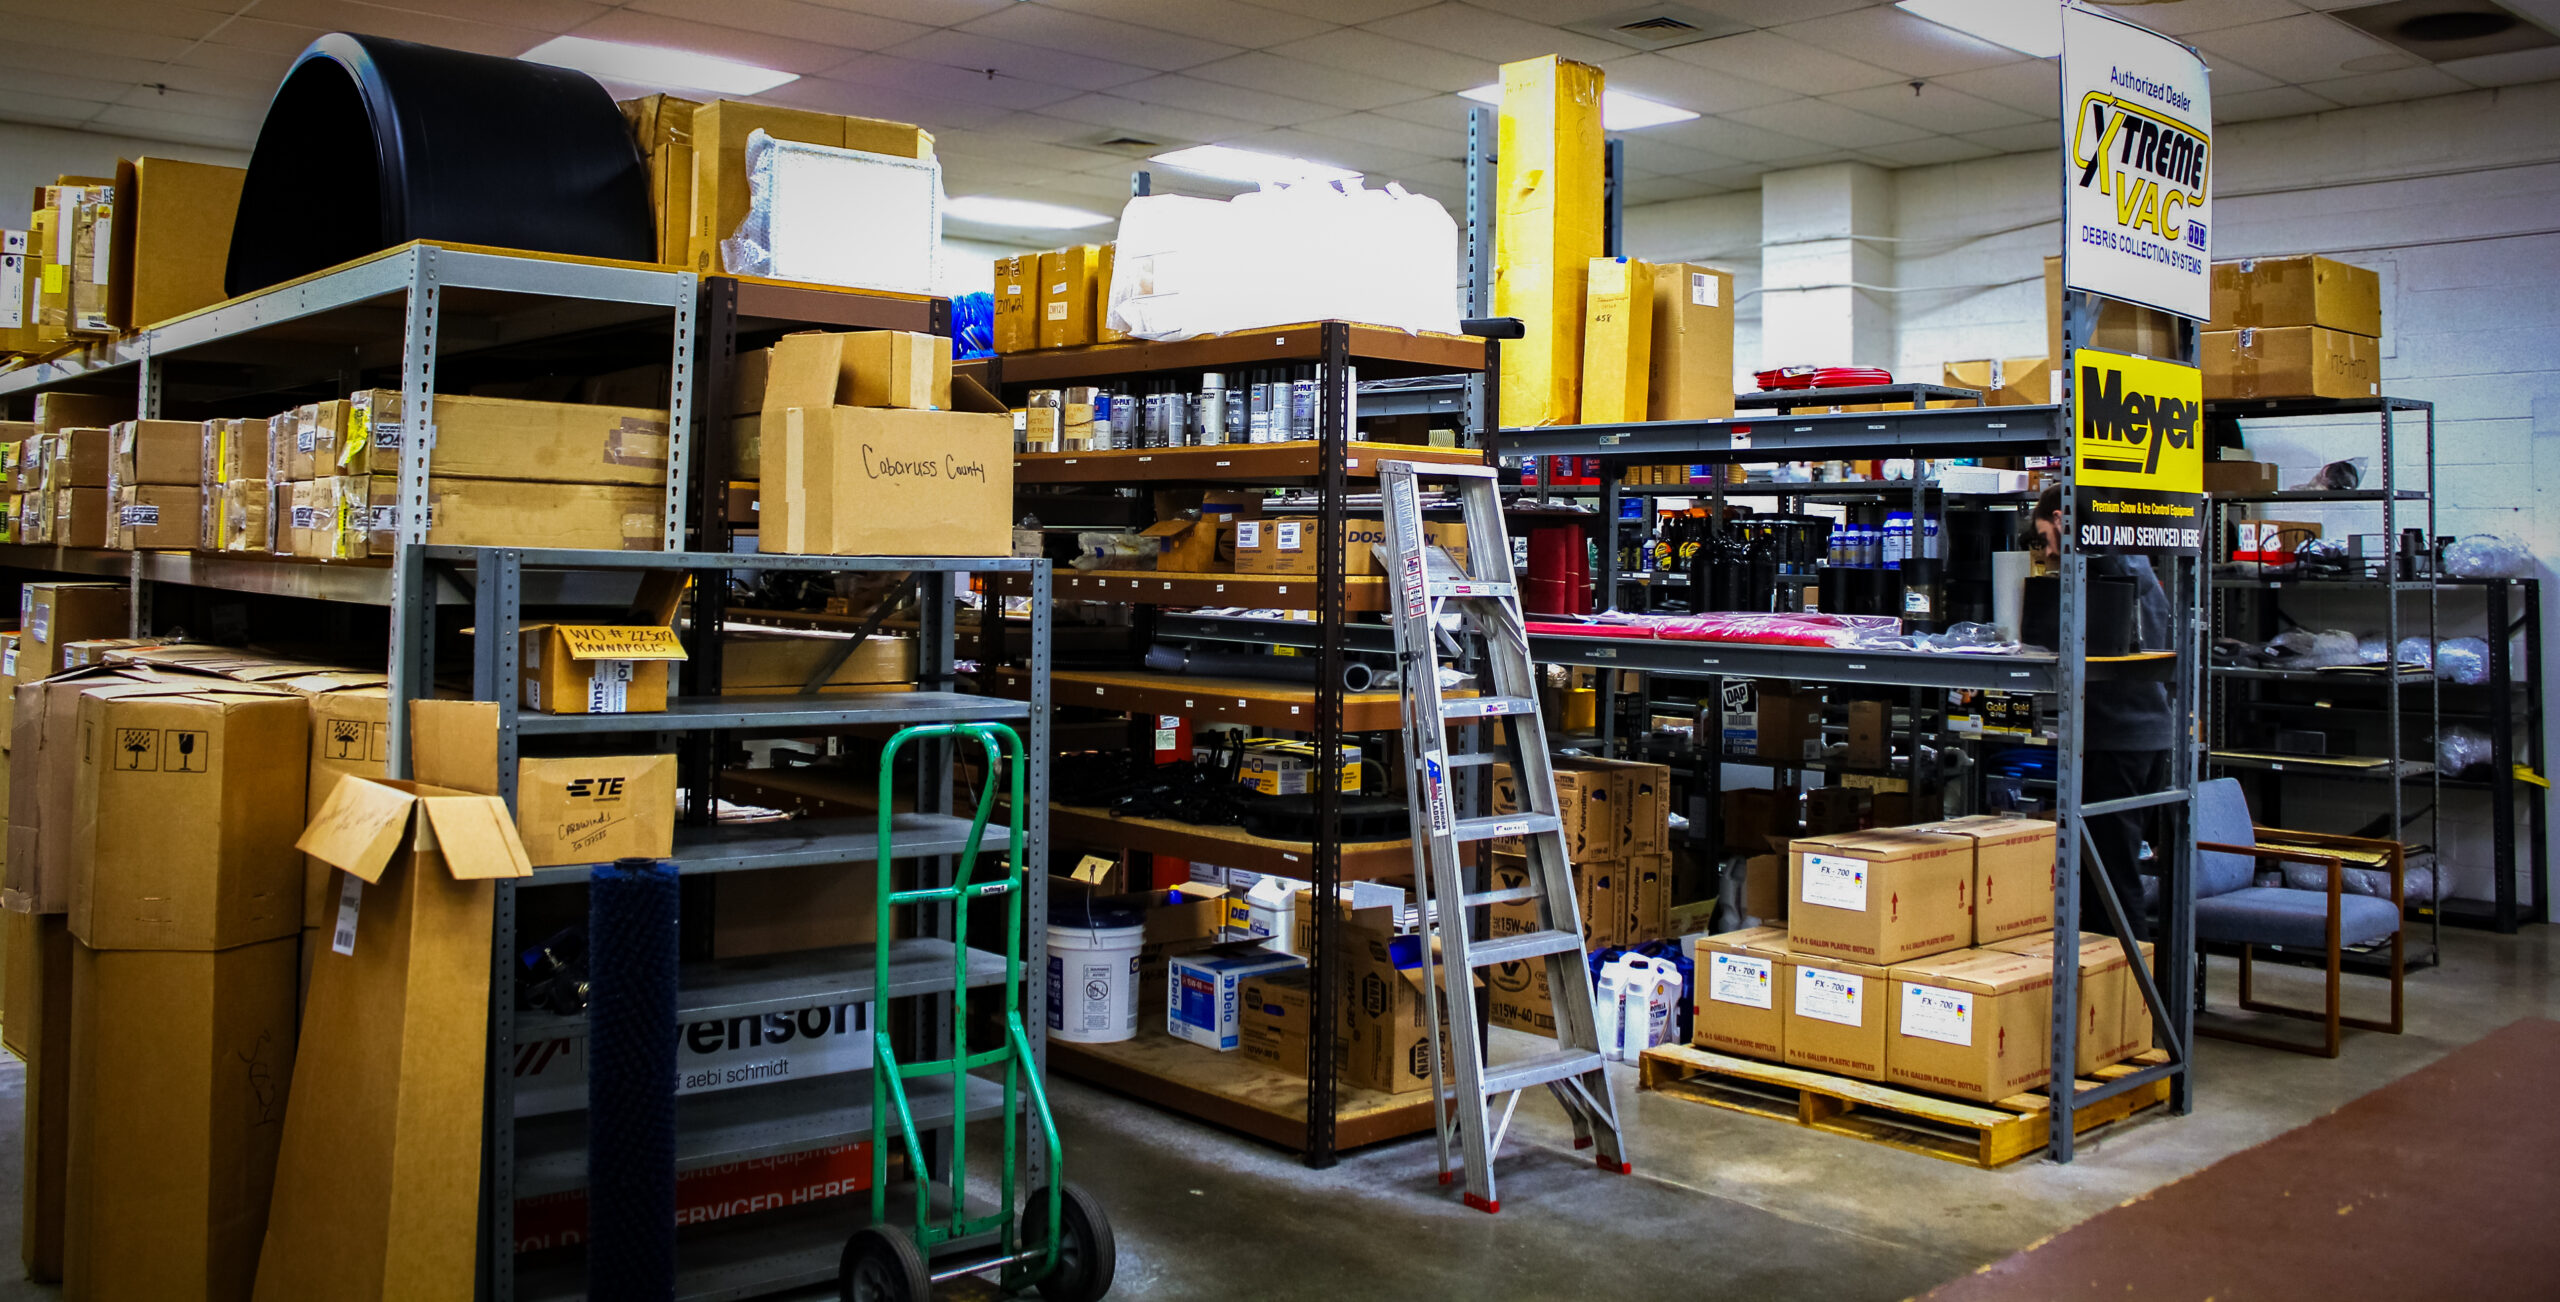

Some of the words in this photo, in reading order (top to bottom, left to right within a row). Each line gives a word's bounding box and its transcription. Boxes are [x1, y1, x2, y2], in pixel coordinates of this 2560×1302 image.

[2111, 66, 2164, 101] Authorized
[2166, 85, 2191, 112] Dealer
[2079, 104, 2204, 195] XTREME
[2116, 170, 2184, 240] VAC
[2082, 225, 2117, 250] DEBRIS
[2119, 236, 2170, 265] COLLECTION
[2171, 250, 2202, 275] SYSTEMS
[2082, 366, 2199, 475] Meyer
[862, 443, 938, 479] Cabaruss
[945, 453, 986, 484] County
[2092, 499, 2120, 513] Premium
[2120, 501, 2136, 514] Snow
[2136, 502, 2142, 514] &
[2142, 502, 2151, 514] Ice
[2151, 503, 2170, 516] Control
[2170, 504, 2195, 519] Equipment
[2081, 524, 2112, 546] SOLD
[2113, 526, 2135, 546] AND
[2136, 527, 2180, 547] SERVICED
[2181, 528, 2200, 548] HERE
[569, 628, 605, 641] WO
[608, 629, 625, 639] #
[575, 642, 666, 654] KANNAPOLIS
[1725, 686, 1747, 704] DAP
[1985, 701, 2007, 712] Gold
[2012, 702, 2030, 711] Gold
[597, 777, 626, 796] TE
[1432, 799, 1441, 831] LADDER
[1438, 797, 1447, 830] AMERICAN
[1820, 866, 1831, 874] FX
[1837, 868, 1850, 877] 700
[1500, 916, 1535, 933] 15W-40
[1809, 938, 1830, 949] GALLON
[1830, 941, 1852, 951] PLASTIC
[1852, 945, 1875, 956] BOTTLES
[1727, 964, 1737, 973] FX
[1743, 967, 1756, 976] 700
[1171, 973, 1182, 1007] Delo
[1368, 979, 1381, 1011] NAPA
[1814, 979, 1825, 989] FX
[1832, 982, 1845, 992] 700
[1224, 991, 1236, 1023] Delo
[1499, 1002, 1533, 1023] 15W-40
[1921, 996, 1932, 1006] FX
[1939, 999, 1953, 1010] 700
[1713, 1033, 1733, 1045] GALLON
[1733, 1037, 1755, 1049] PLASTIC
[1754, 1041, 1776, 1053] BOTTLES
[1417, 1044, 1430, 1073] NAPA
[1806, 1051, 1828, 1064] GALLON
[1829, 1056, 1850, 1068] PLASTIC
[1851, 1060, 1875, 1072] BOTTLES
[686, 1068, 721, 1089] aebi
[726, 1058, 789, 1083] schmidt
[1910, 1070, 1932, 1083] GALLON
[1932, 1075, 1957, 1087] PLASTIC
[1957, 1080, 1982, 1092] BOTTLES
